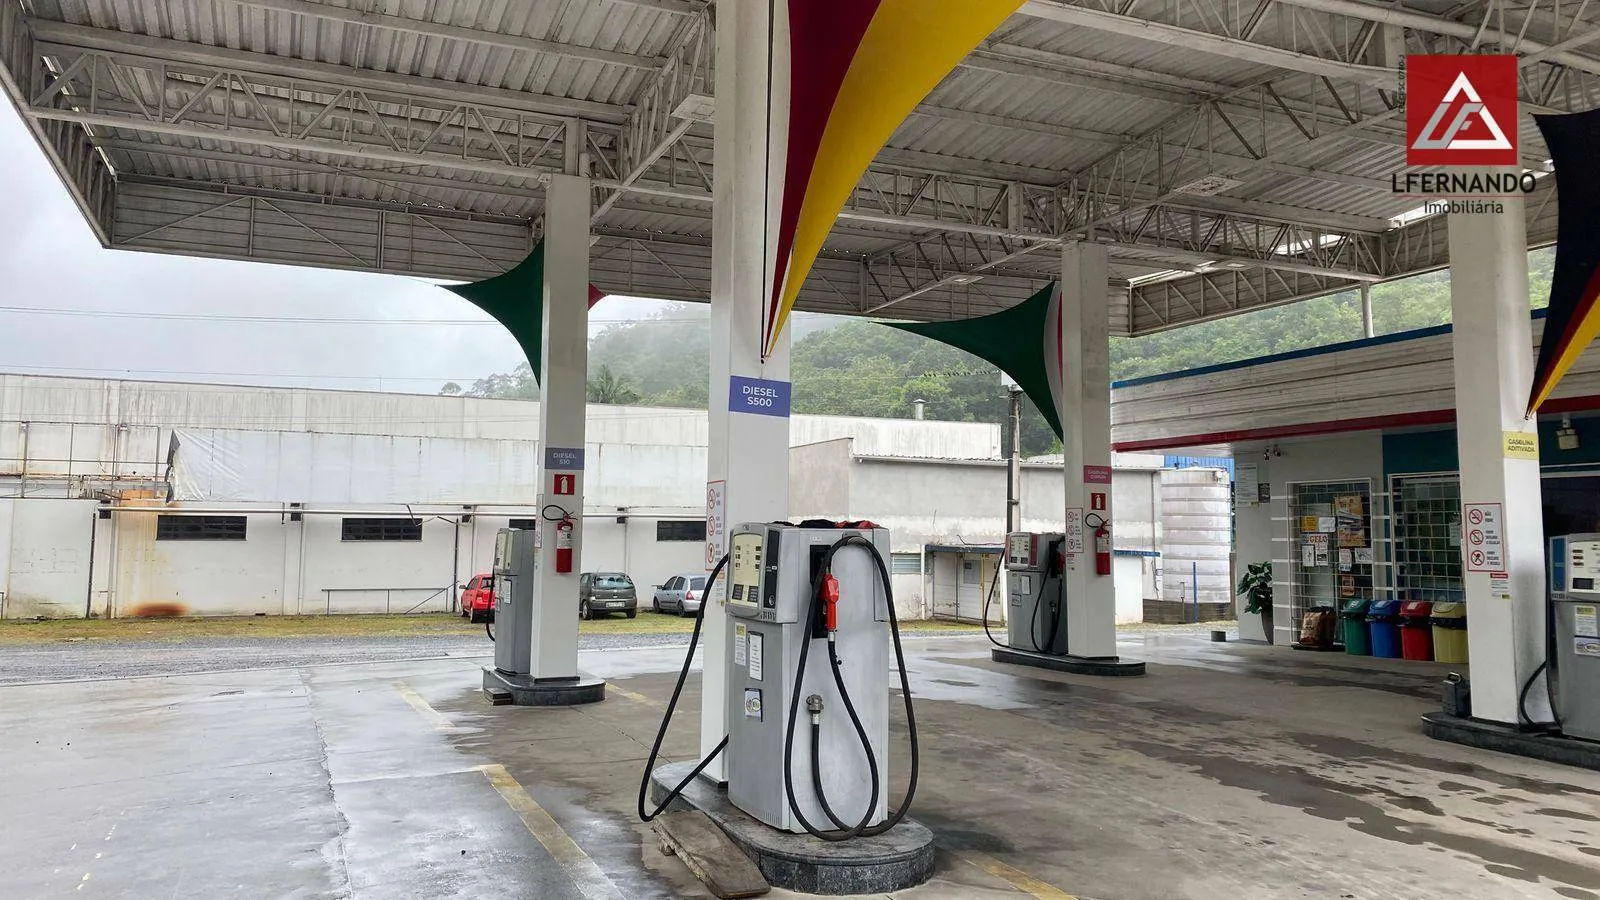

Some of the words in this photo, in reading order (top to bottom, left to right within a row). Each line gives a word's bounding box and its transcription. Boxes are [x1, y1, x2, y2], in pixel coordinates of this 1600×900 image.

[742, 385, 778, 398] DIESEL
[747, 396, 772, 407] S500
[1508, 438, 1534, 446] GASOLINA
[1507, 445, 1535, 453] ADITIVADA
